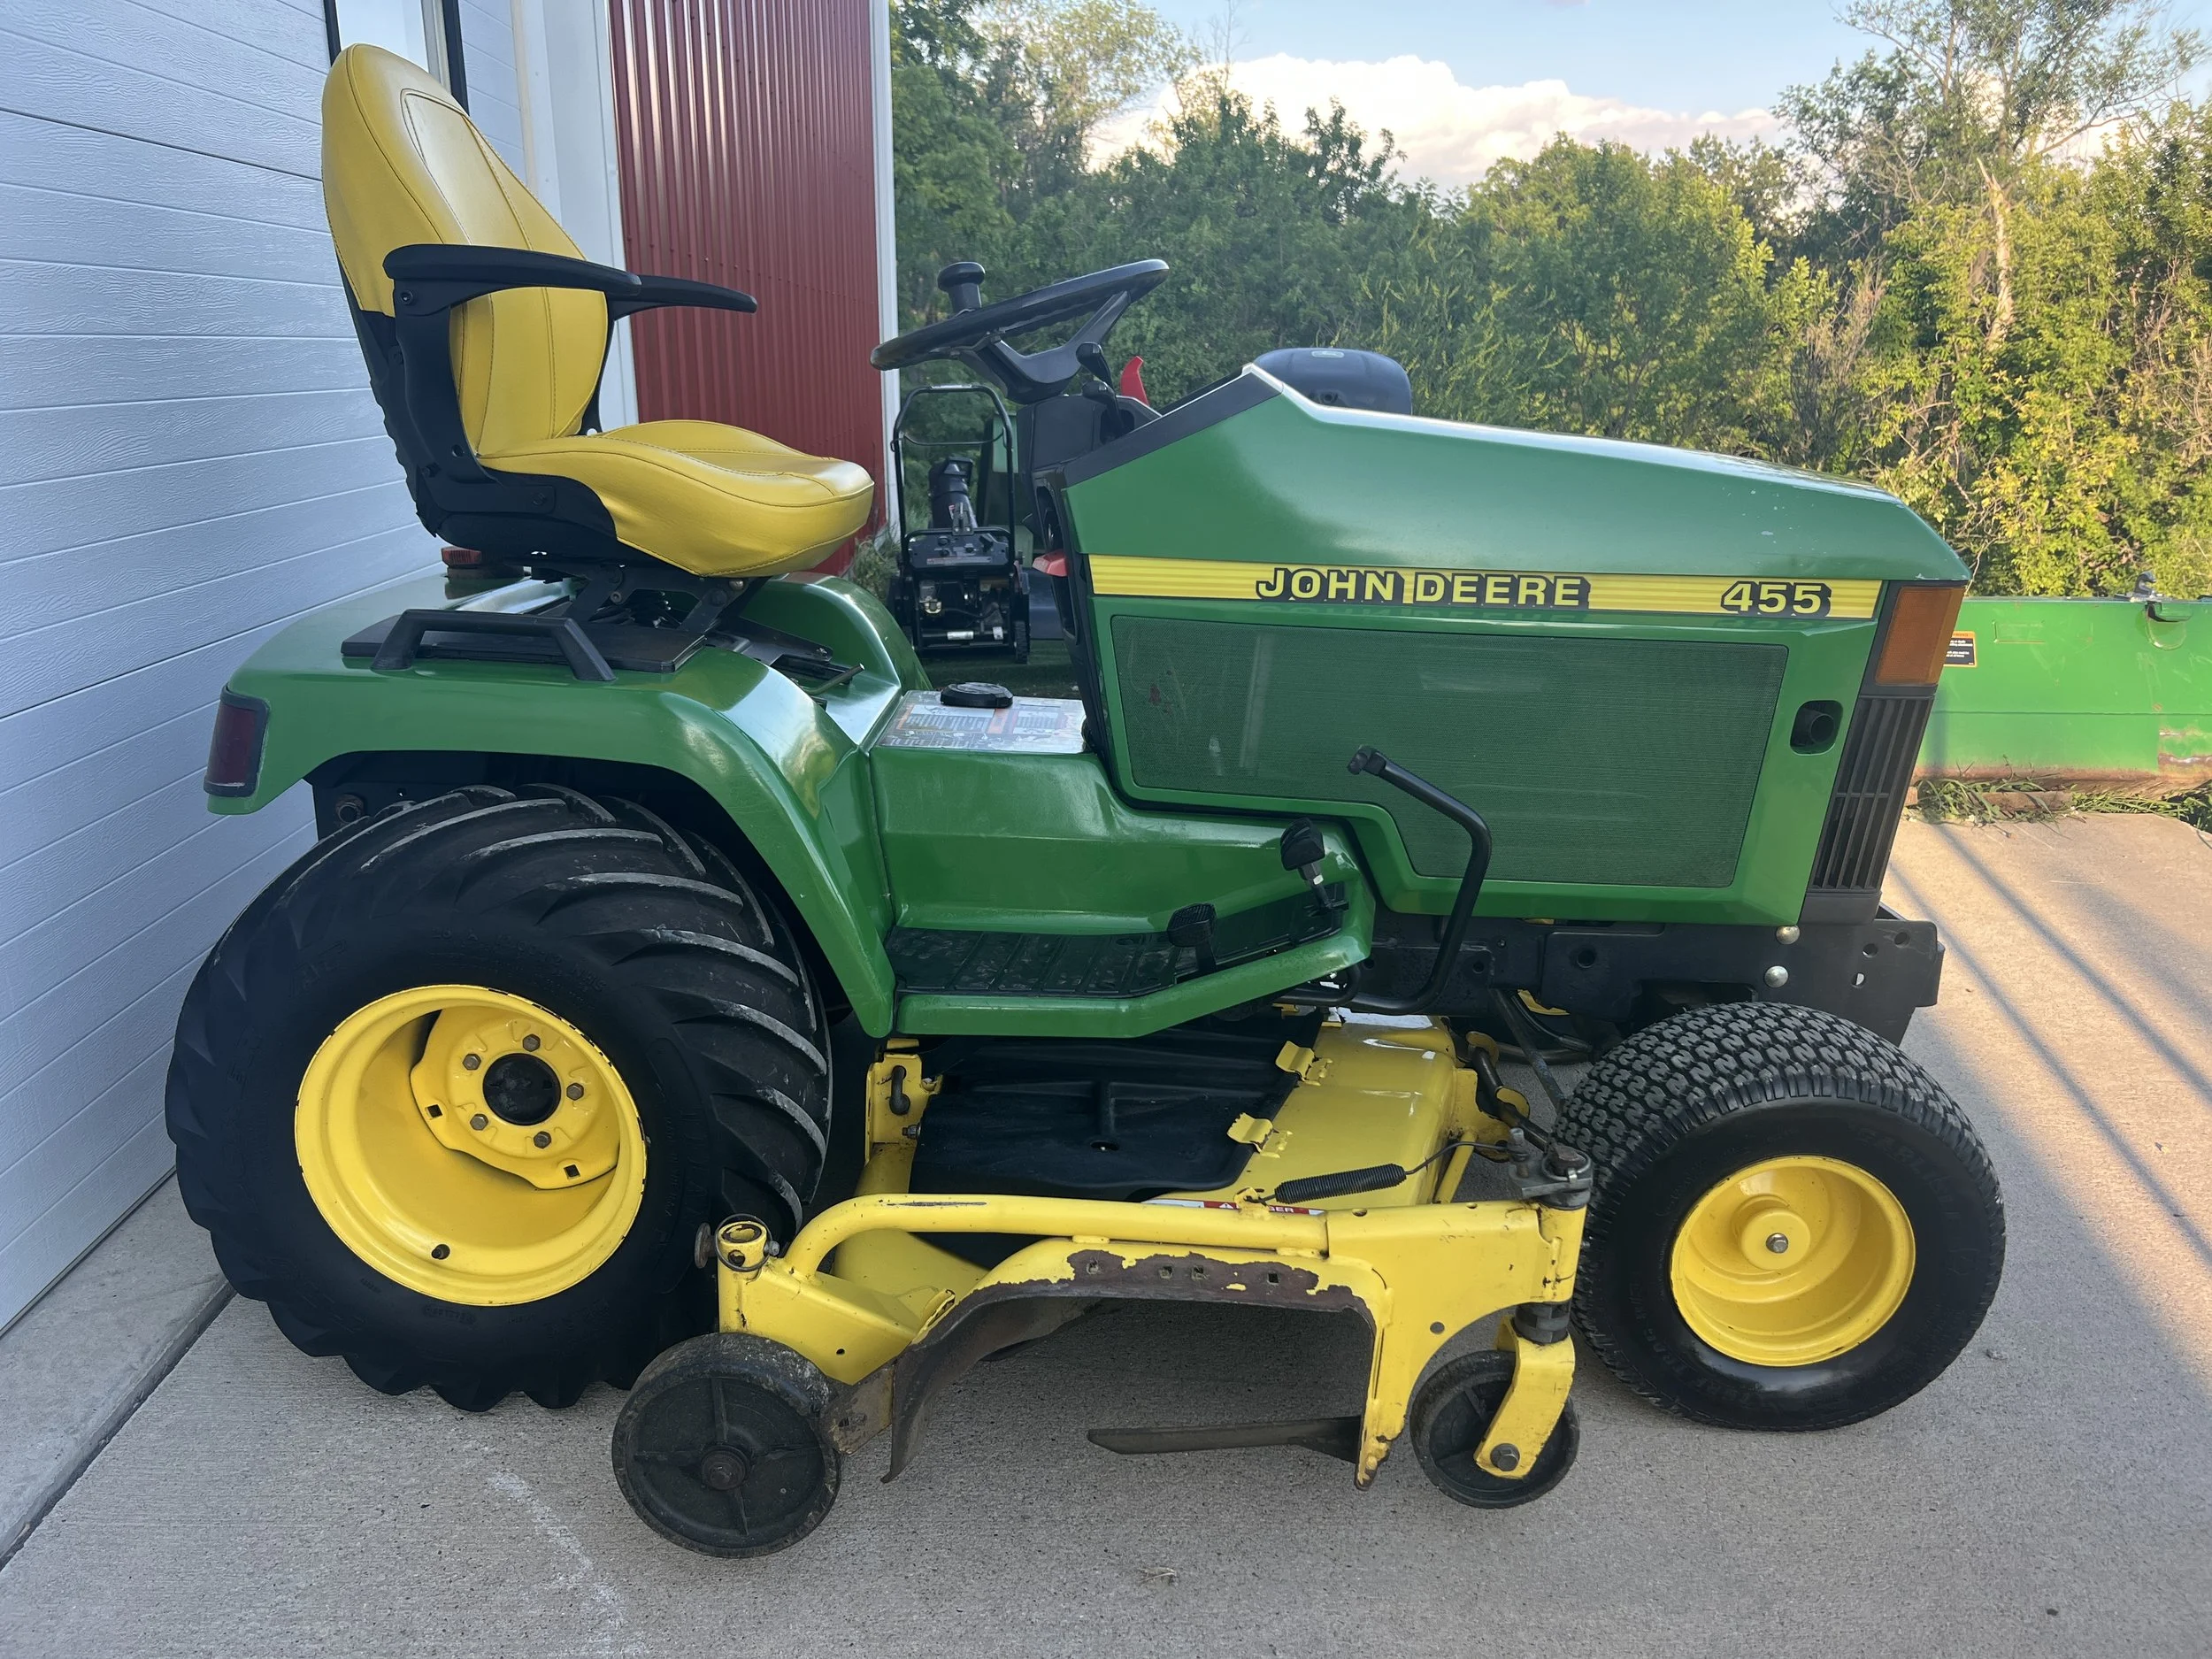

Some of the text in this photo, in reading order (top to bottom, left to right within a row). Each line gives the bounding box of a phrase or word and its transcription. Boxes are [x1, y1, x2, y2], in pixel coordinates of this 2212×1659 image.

[1256, 568, 1586, 607] JOHN DEERE
[1721, 581, 1830, 617] 455
